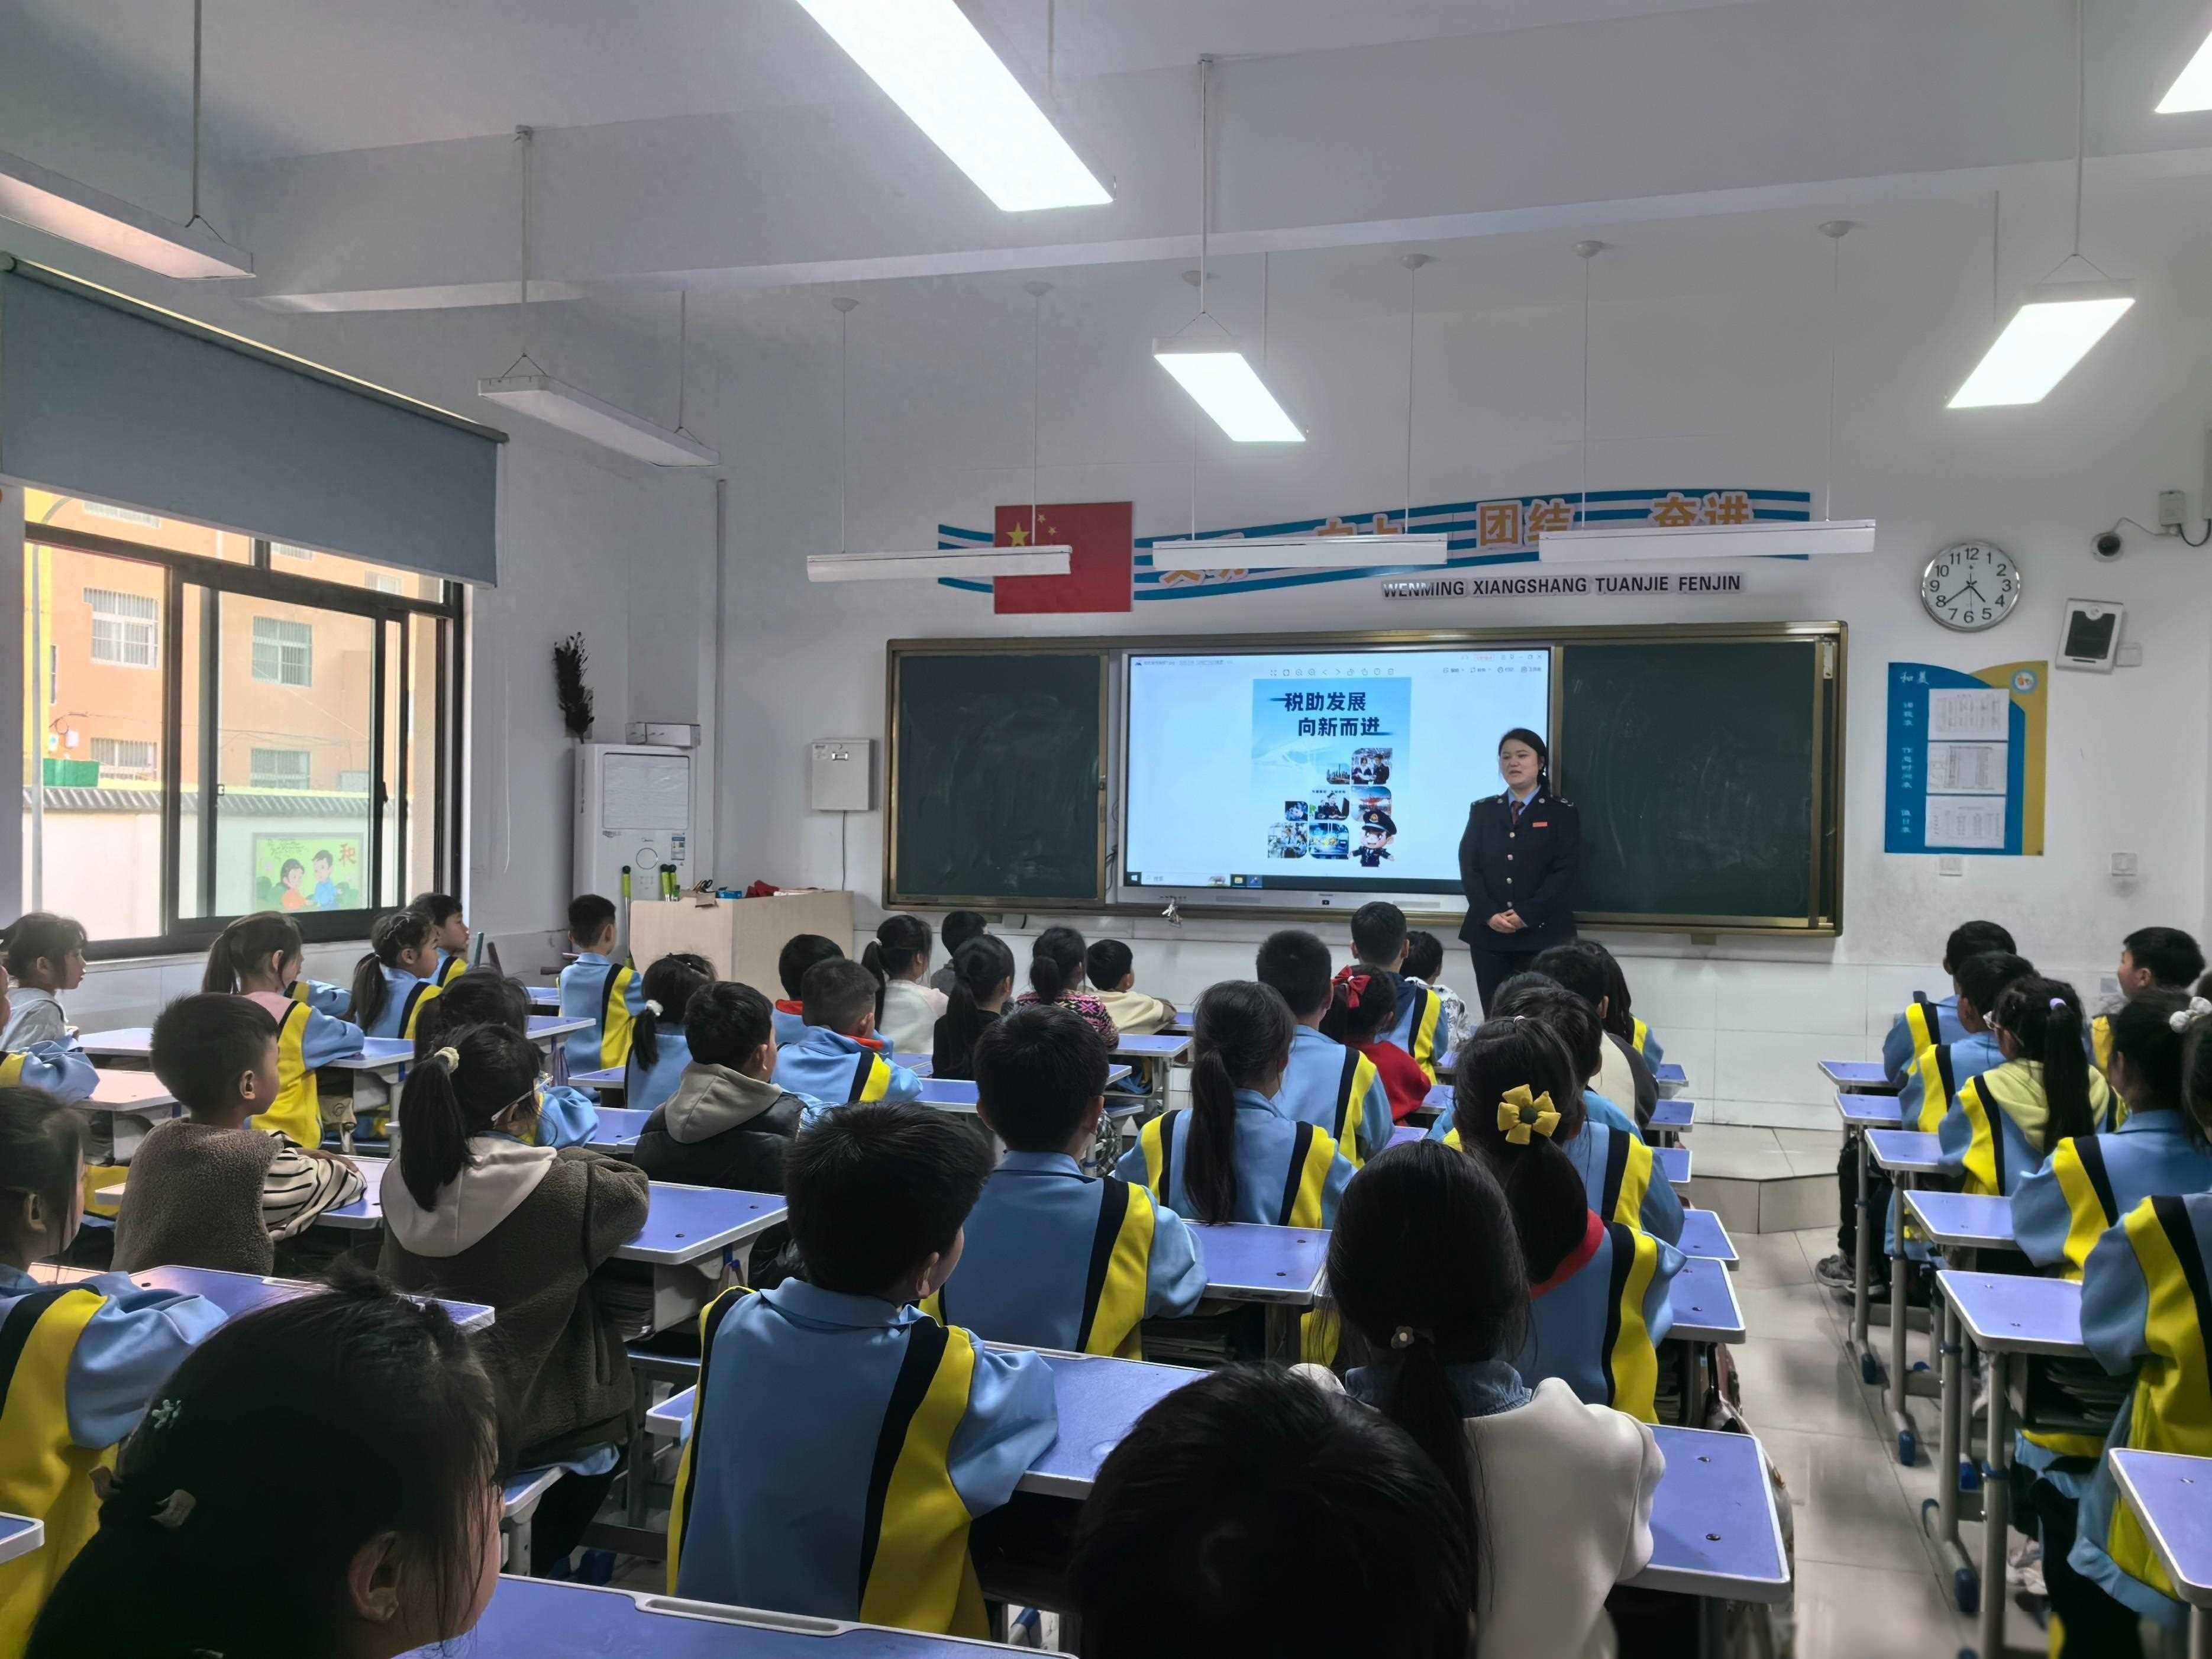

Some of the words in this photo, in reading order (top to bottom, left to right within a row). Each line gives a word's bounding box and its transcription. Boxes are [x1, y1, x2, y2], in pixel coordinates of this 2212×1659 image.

[1480, 502, 1571, 546] 团结
[1949, 552, 1960, 564] 11
[1965, 548, 1980, 560] 12
[1987, 552, 1991, 564] 1
[1935, 565, 1949, 577] 10
[1996, 563, 2006, 576] 2
[1383, 580, 1464, 598] WENMING
[1473, 577, 1587, 595] XIANGSHANG
[1596, 576, 1669, 592] TUANJIE
[1678, 575, 1740, 591] FENJIN
[1930, 580, 1940, 592] 9
[2002, 579, 2011, 592] 3
[1936, 595, 1946, 608] 8
[1995, 594, 2005, 607] 4
[1948, 608, 1958, 619] 7
[1964, 611, 1974, 623] 6
[1982, 608, 1992, 620] 5
[1284, 692, 1367, 712] 税助发展
[1299, 716, 1380, 737] 向新而进
